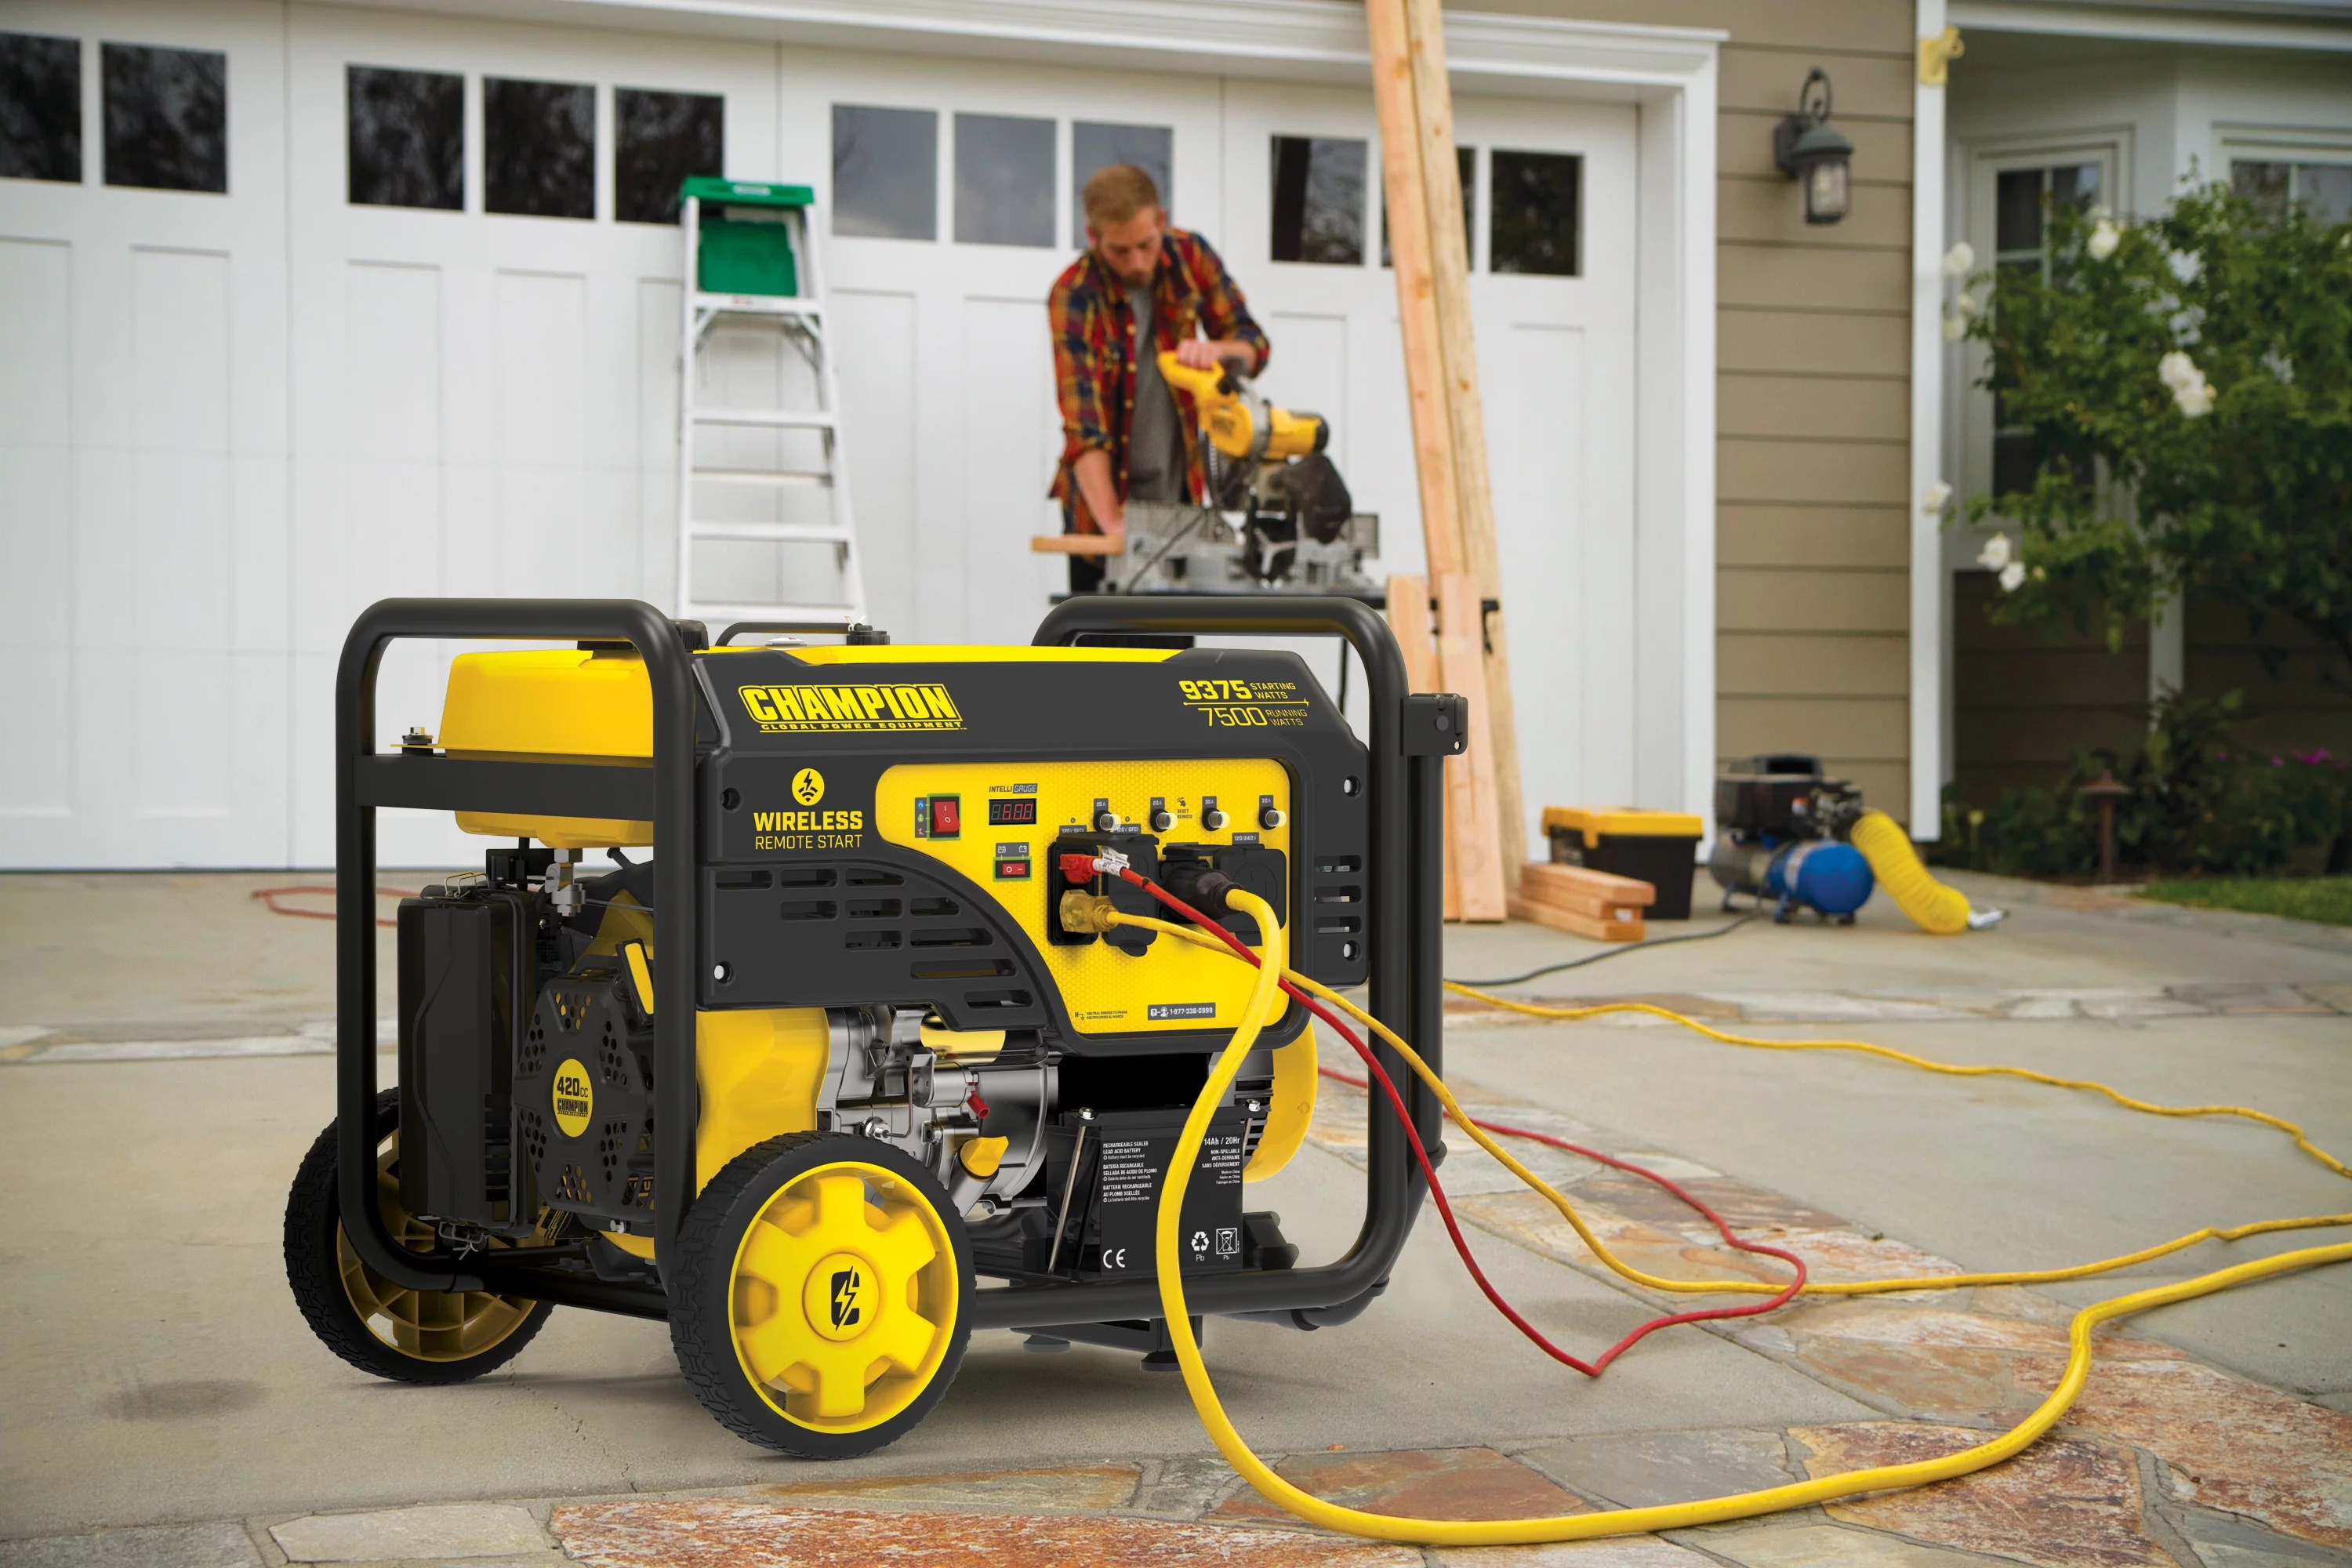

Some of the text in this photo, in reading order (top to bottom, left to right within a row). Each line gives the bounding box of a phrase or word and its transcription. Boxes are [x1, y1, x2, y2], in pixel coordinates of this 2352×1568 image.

[1179, 681, 1253, 700] 9375
[740, 684, 960, 721] CHAMPION
[1198, 707, 1268, 727] 7500
[1265, 709, 1308, 717] RUNNING
[879, 721, 961, 730] EQUIPMENT
[753, 811, 862, 831] WIRELESS
[755, 834, 862, 850] REMOTE START
[557, 1098, 588, 1113] CHAMPION
[1204, 1137, 1219, 1145] 14Ah
[1225, 1136, 1240, 1145] 20Hr
[1102, 1248, 1125, 1269] CE
